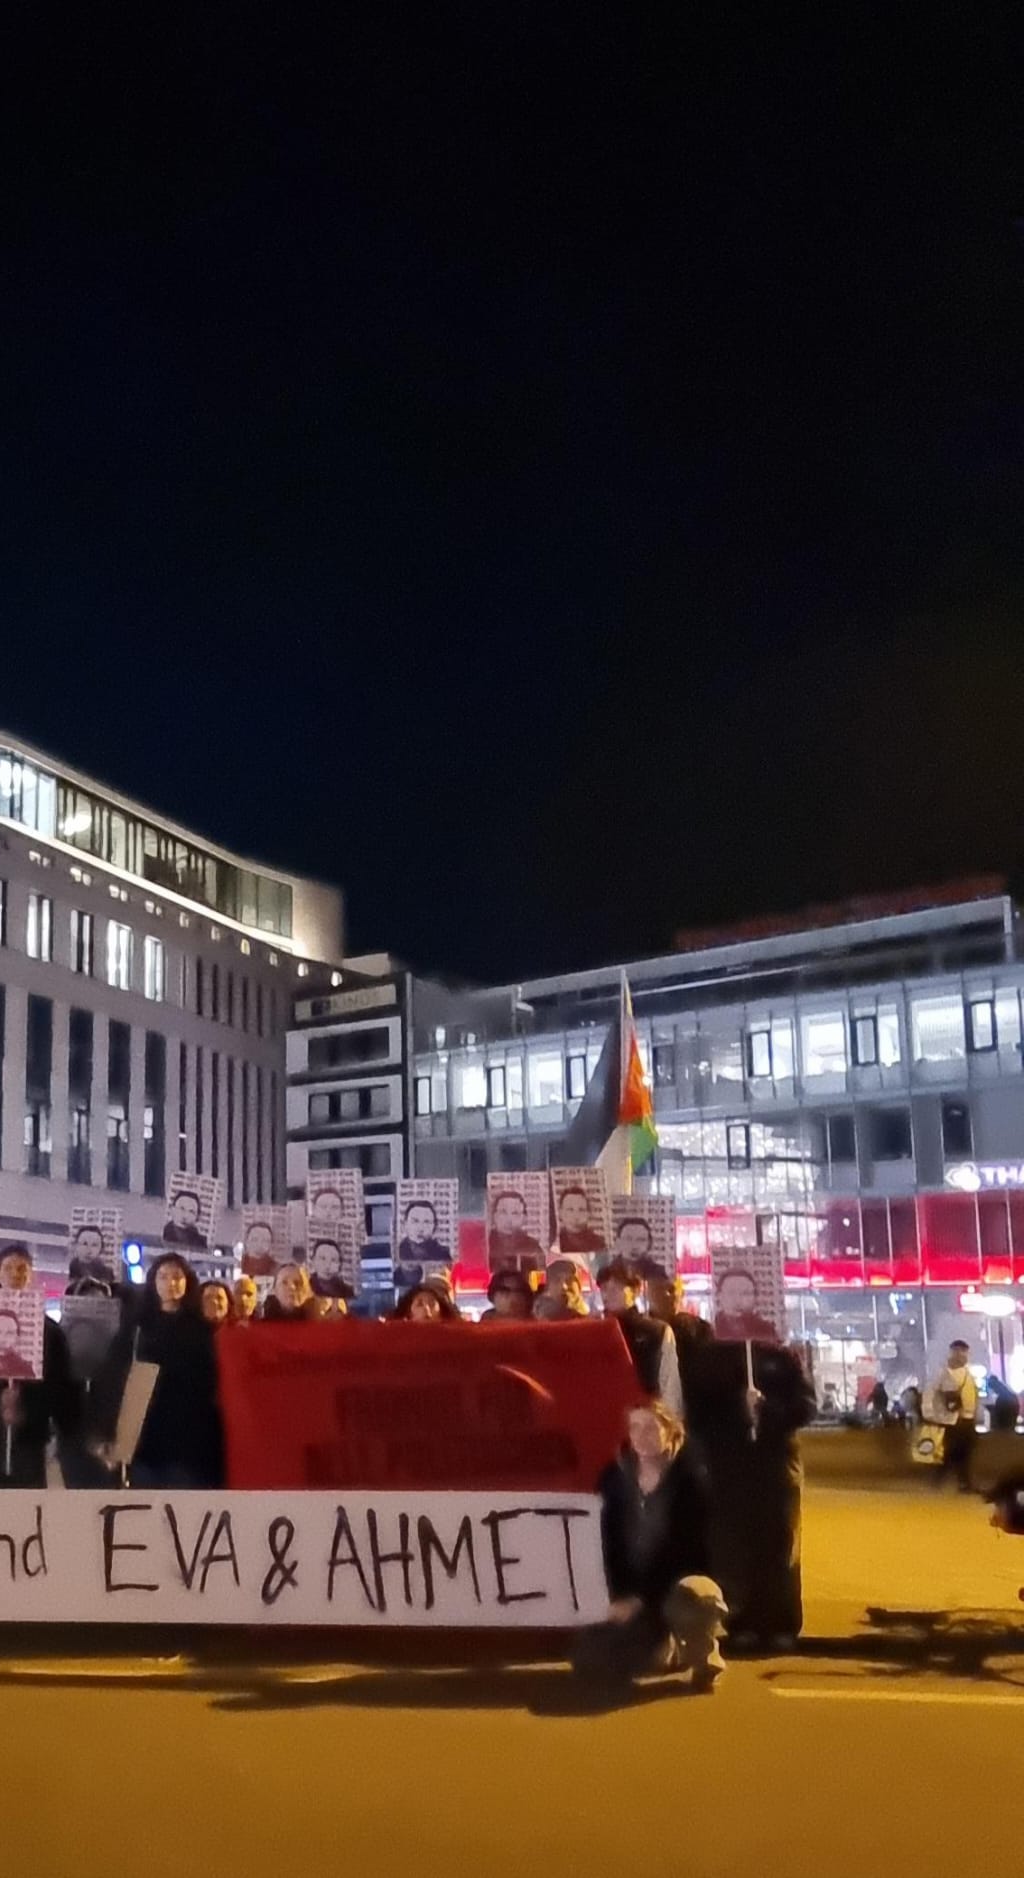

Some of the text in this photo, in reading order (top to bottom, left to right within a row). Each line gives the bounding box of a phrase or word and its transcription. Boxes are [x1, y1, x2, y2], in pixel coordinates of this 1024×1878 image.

[98, 1503, 241, 1594] EVA
[261, 1515, 299, 1606] &
[327, 1505, 590, 1614] AHMET
